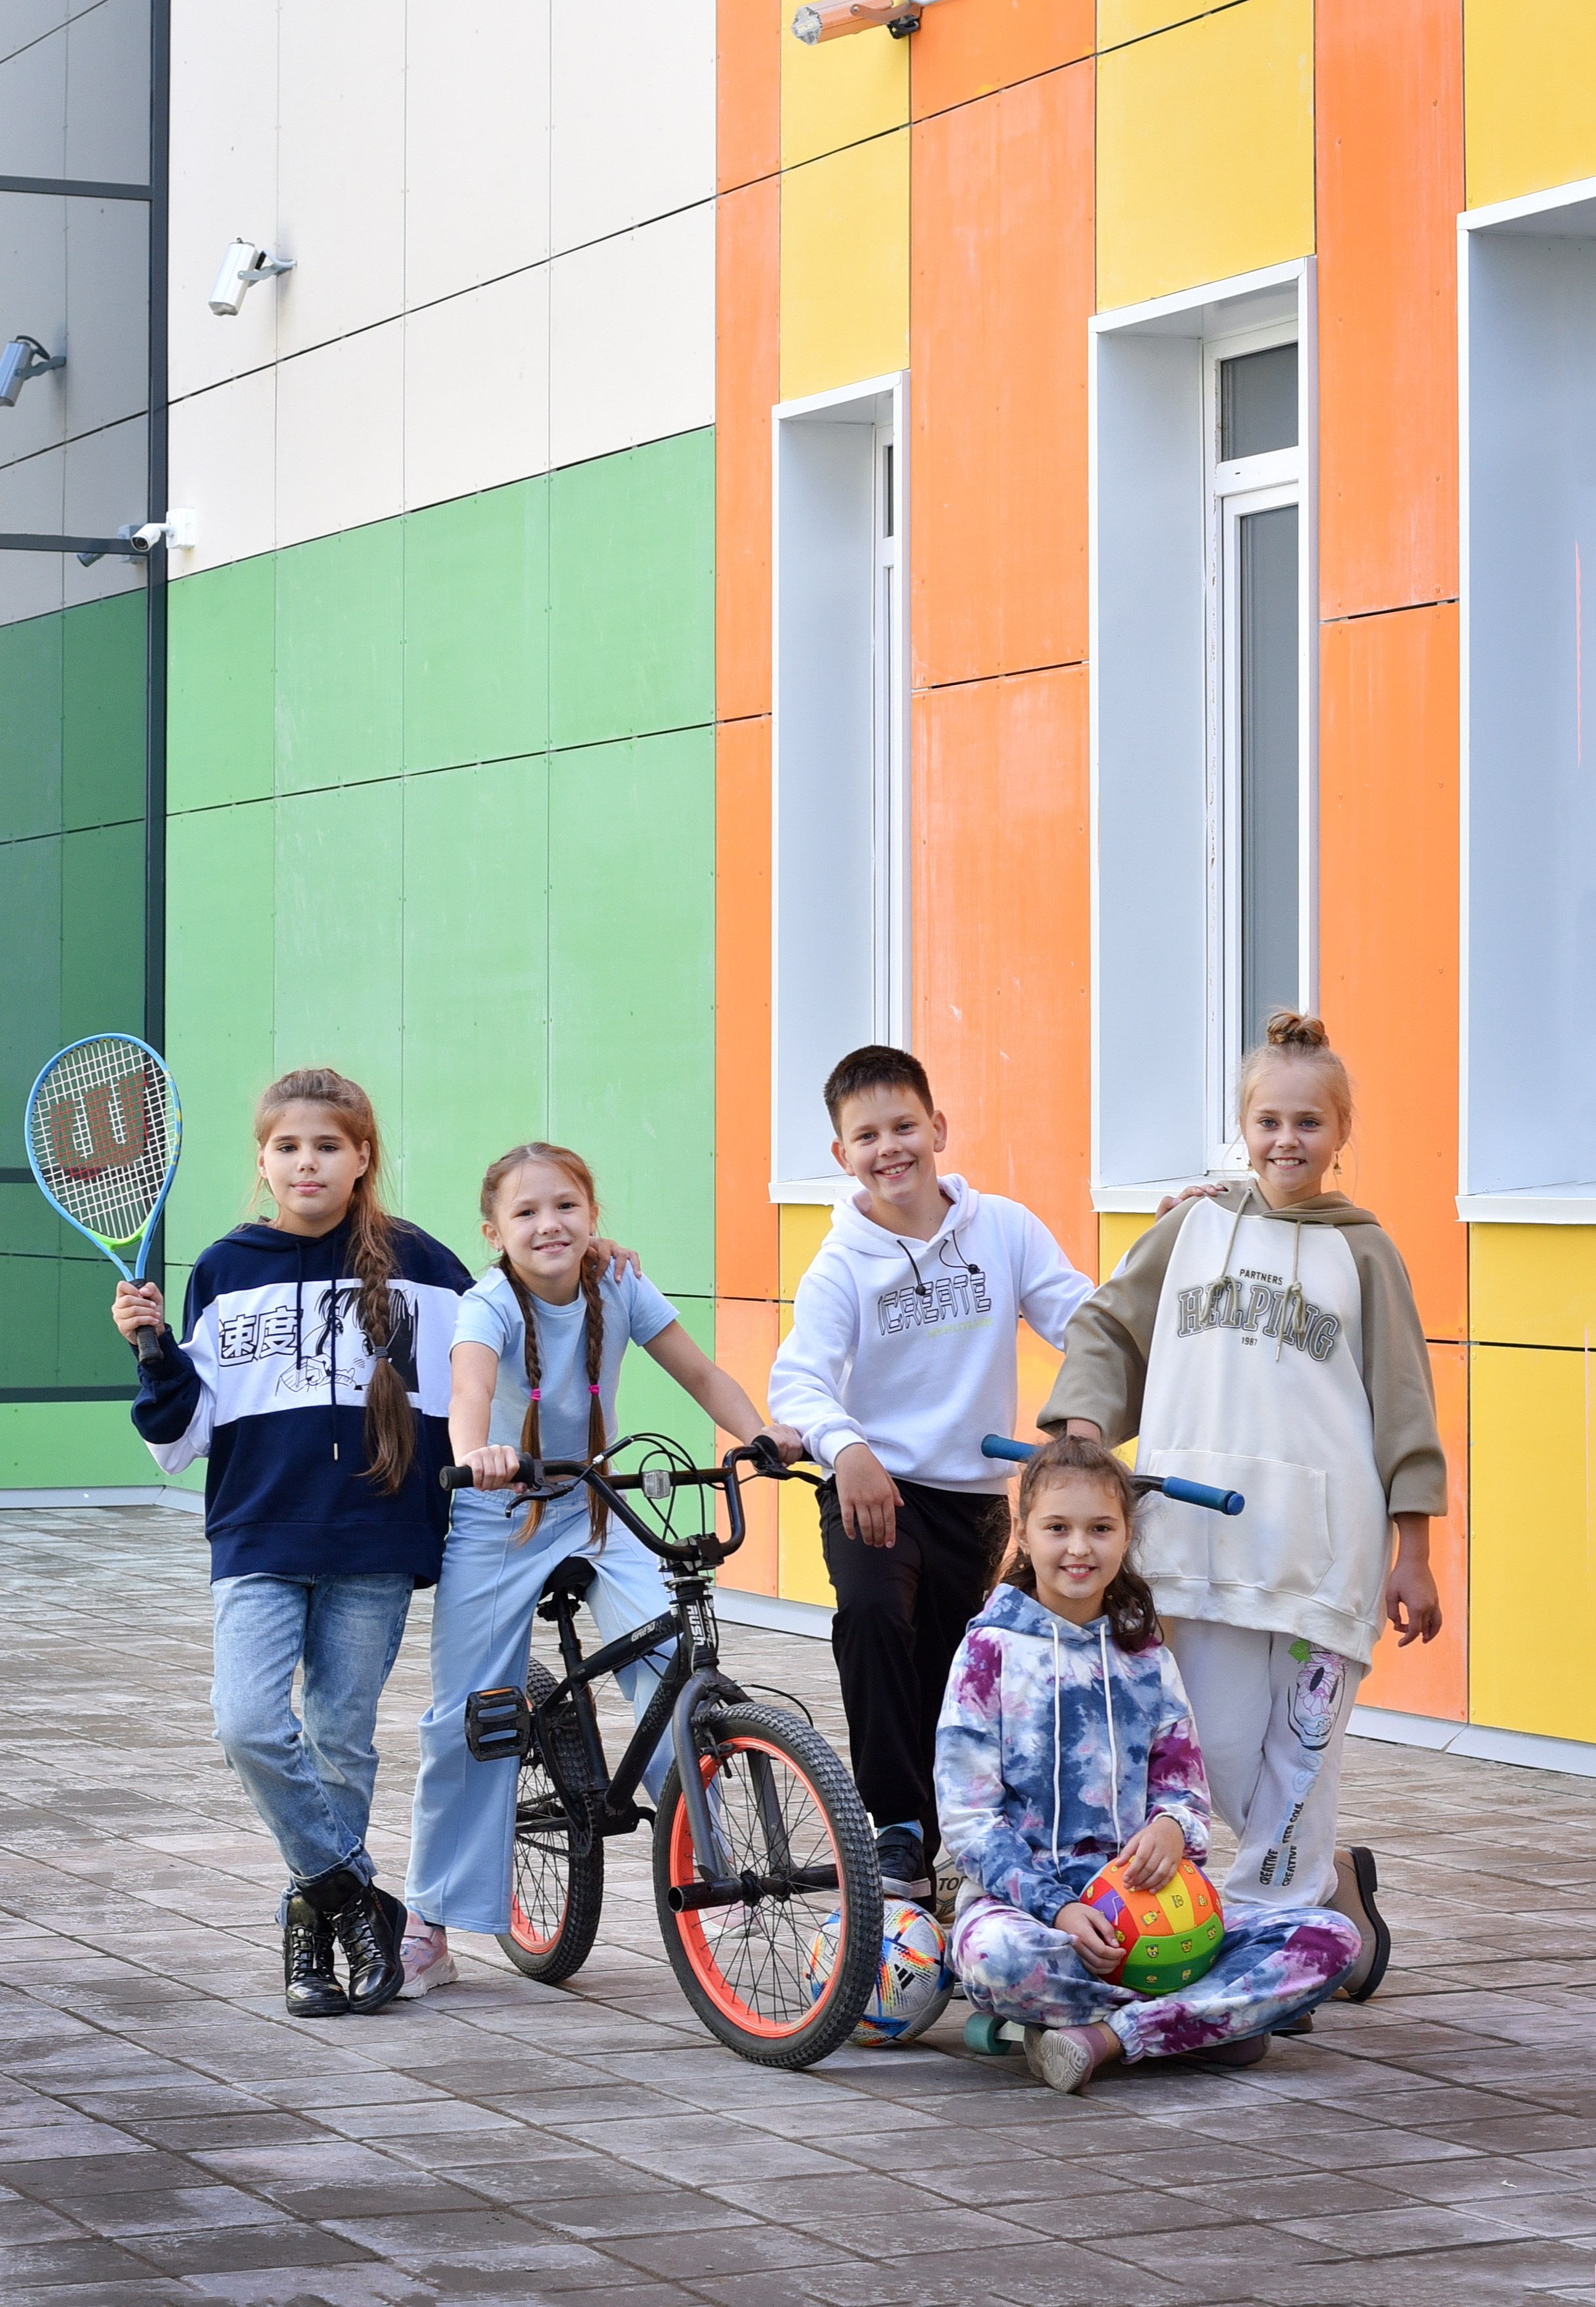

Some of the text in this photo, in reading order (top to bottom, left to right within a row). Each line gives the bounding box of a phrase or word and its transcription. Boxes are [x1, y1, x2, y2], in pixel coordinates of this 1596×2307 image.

[1238, 1268, 1283, 1286] PARTNERS
[218, 1305, 304, 1367] 速度
[1241, 1336, 1258, 1346] 1987
[1289, 1802, 1304, 1823] SOUL
[1259, 1848, 1279, 1886] CREATIVE
[1282, 1844, 1297, 1887] CREATIVE
